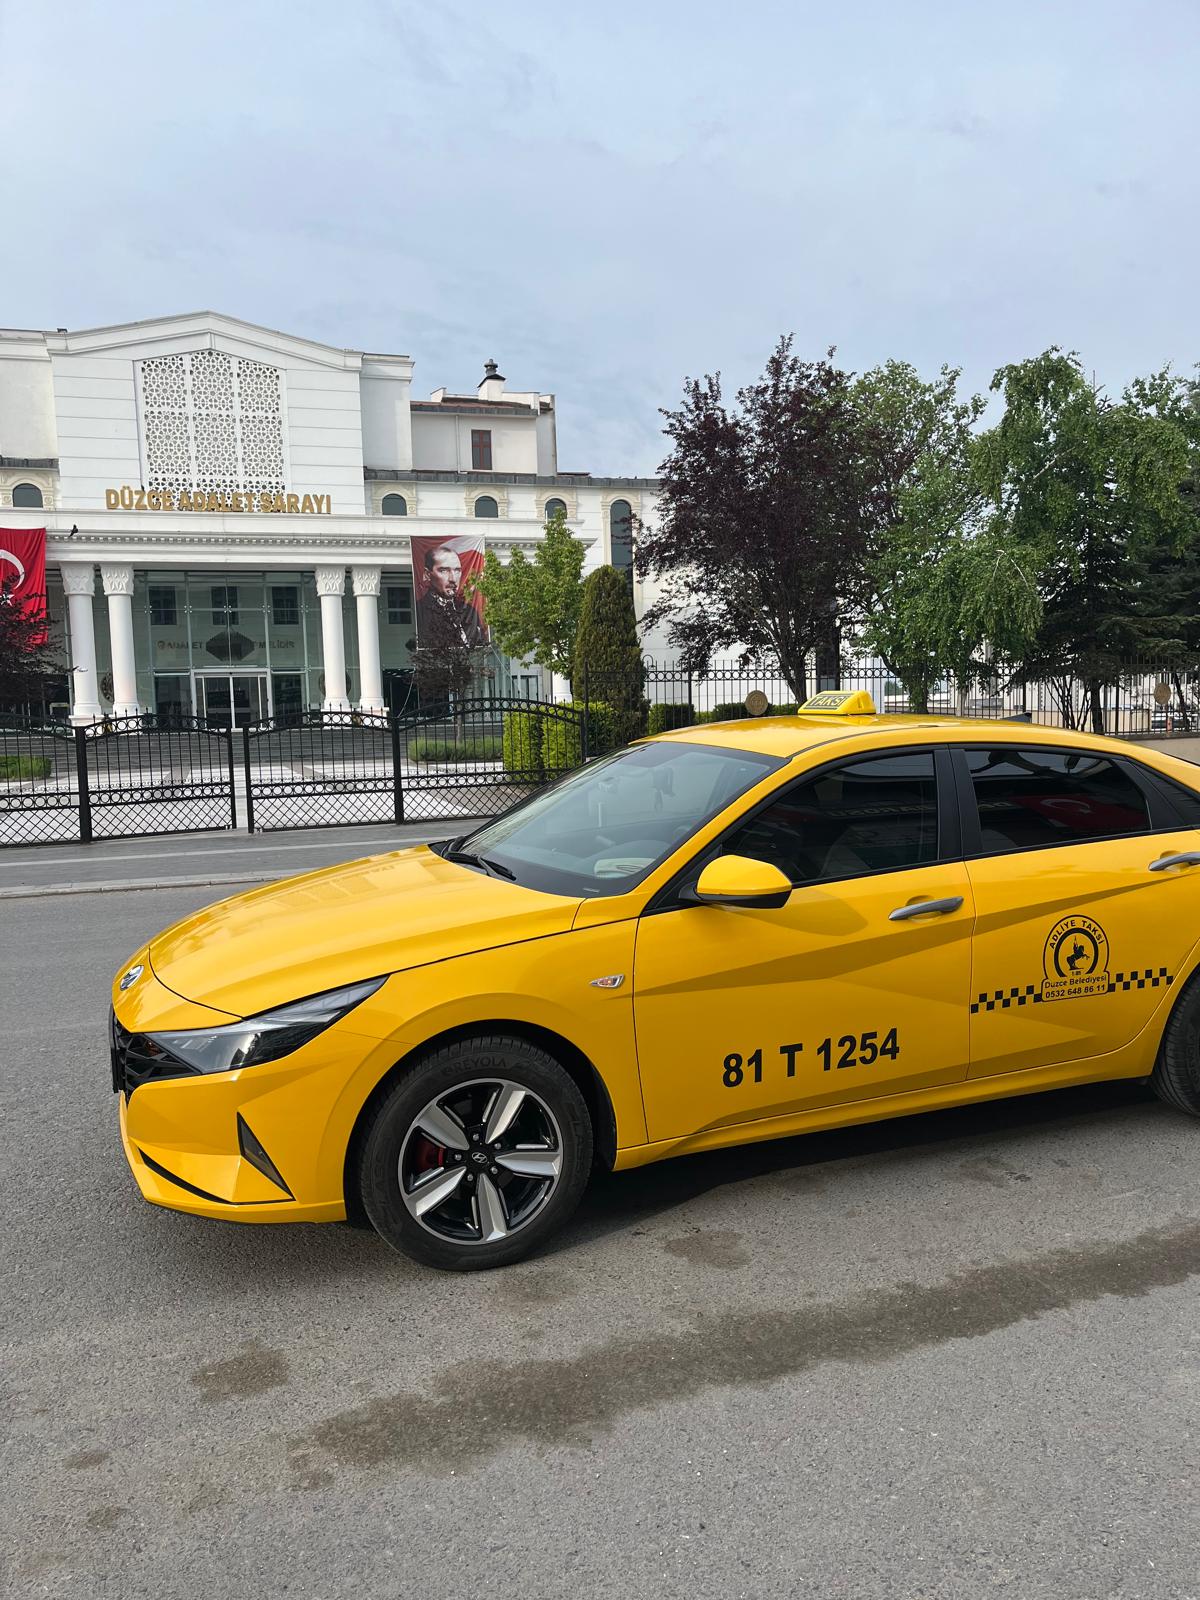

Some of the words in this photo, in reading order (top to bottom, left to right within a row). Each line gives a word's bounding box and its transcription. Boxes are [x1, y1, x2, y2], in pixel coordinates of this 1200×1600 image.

[105, 486, 173, 511] DÜZCE
[179, 490, 256, 512] ADALET
[261, 492, 332, 514] SARAYI
[1045, 989, 1065, 998] 0532
[1067, 987, 1082, 995] 648
[1084, 985, 1094, 993] 86
[1096, 984, 1105, 992] 11
[722, 1048, 763, 1088] 81
[779, 1043, 803, 1077] T
[817, 1028, 900, 1071] 1254
